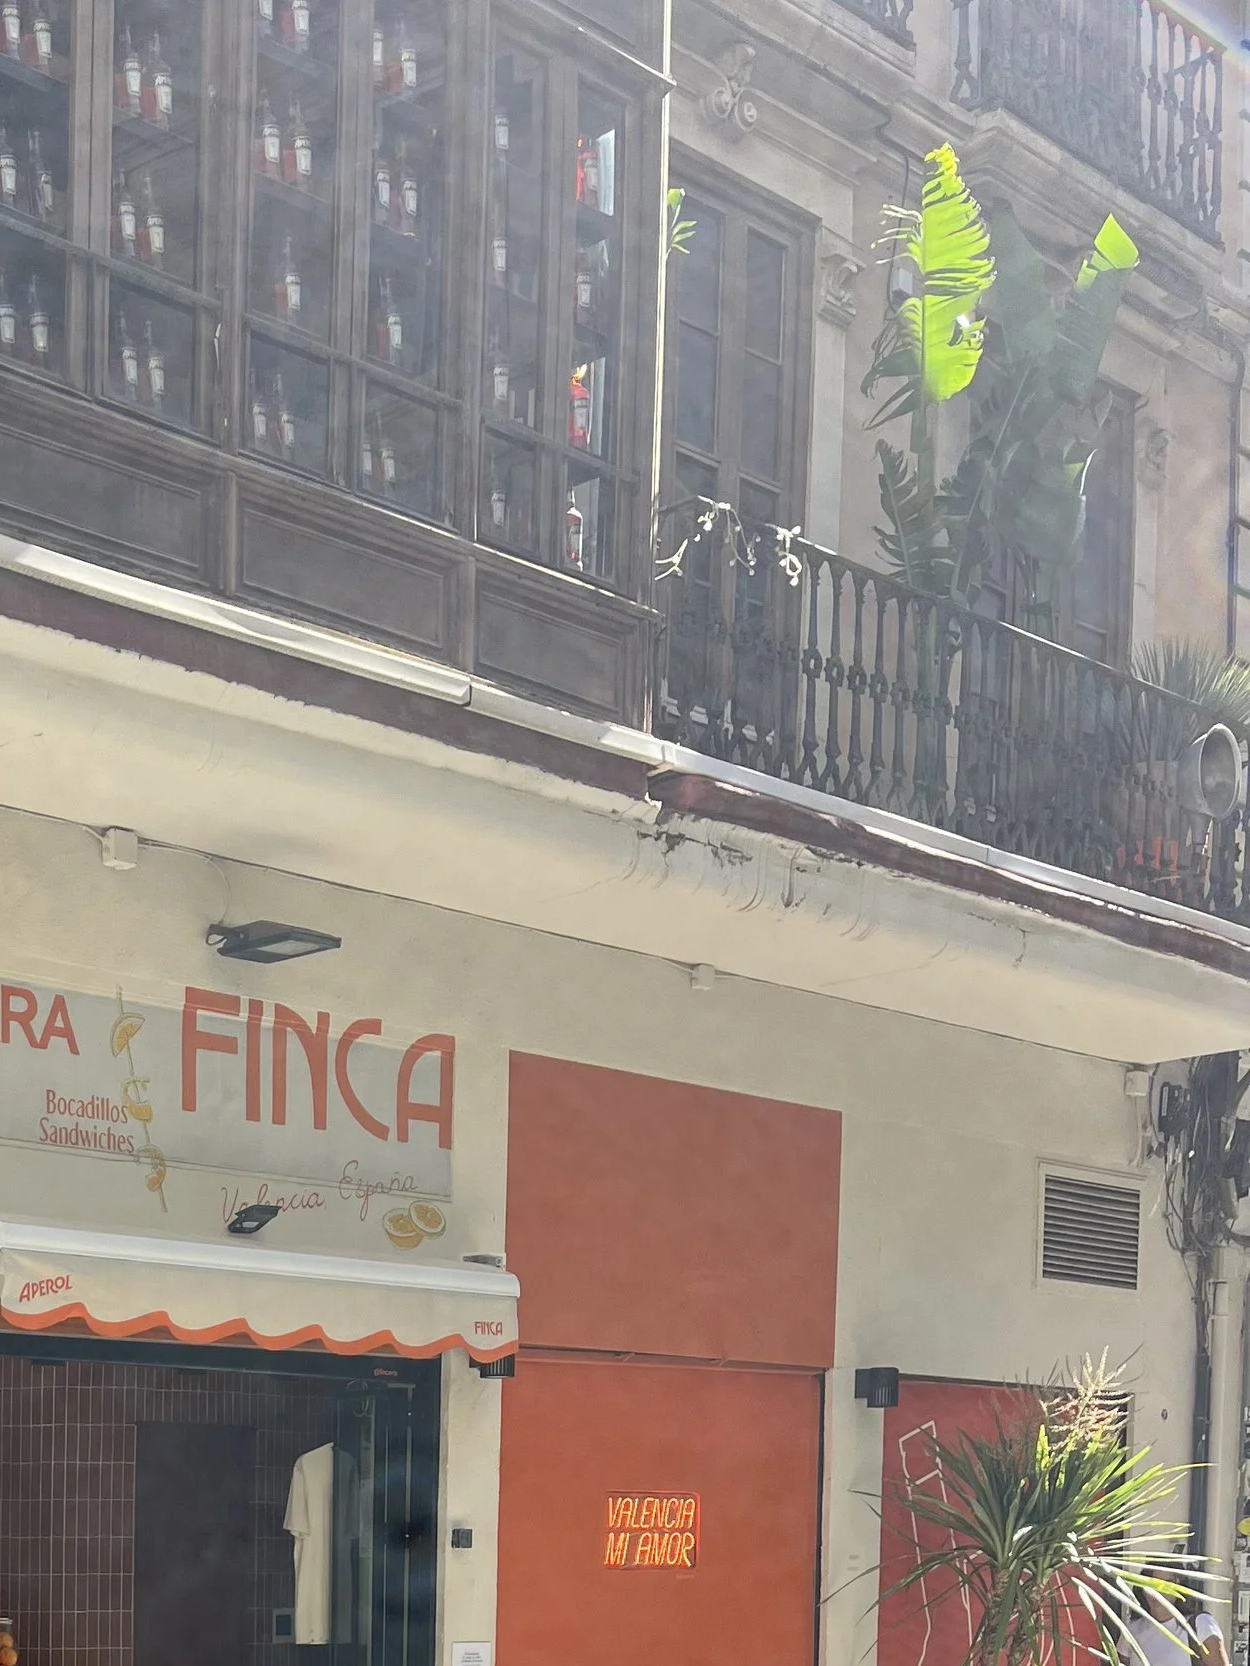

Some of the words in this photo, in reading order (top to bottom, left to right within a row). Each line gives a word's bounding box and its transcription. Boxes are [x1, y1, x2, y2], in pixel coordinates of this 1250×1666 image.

[181, 985, 456, 1150] FINCA
[45, 1089, 129, 1124] Bocadillos
[38, 1117, 135, 1154] Sandwiches
[338, 1160, 418, 1222] España
[19, 1274, 73, 1303] APEROL
[474, 1321, 503, 1336] FINCA
[607, 1497, 696, 1529] VALENCIA
[604, 1532, 630, 1566] MI
[635, 1532, 696, 1567] AMOR
